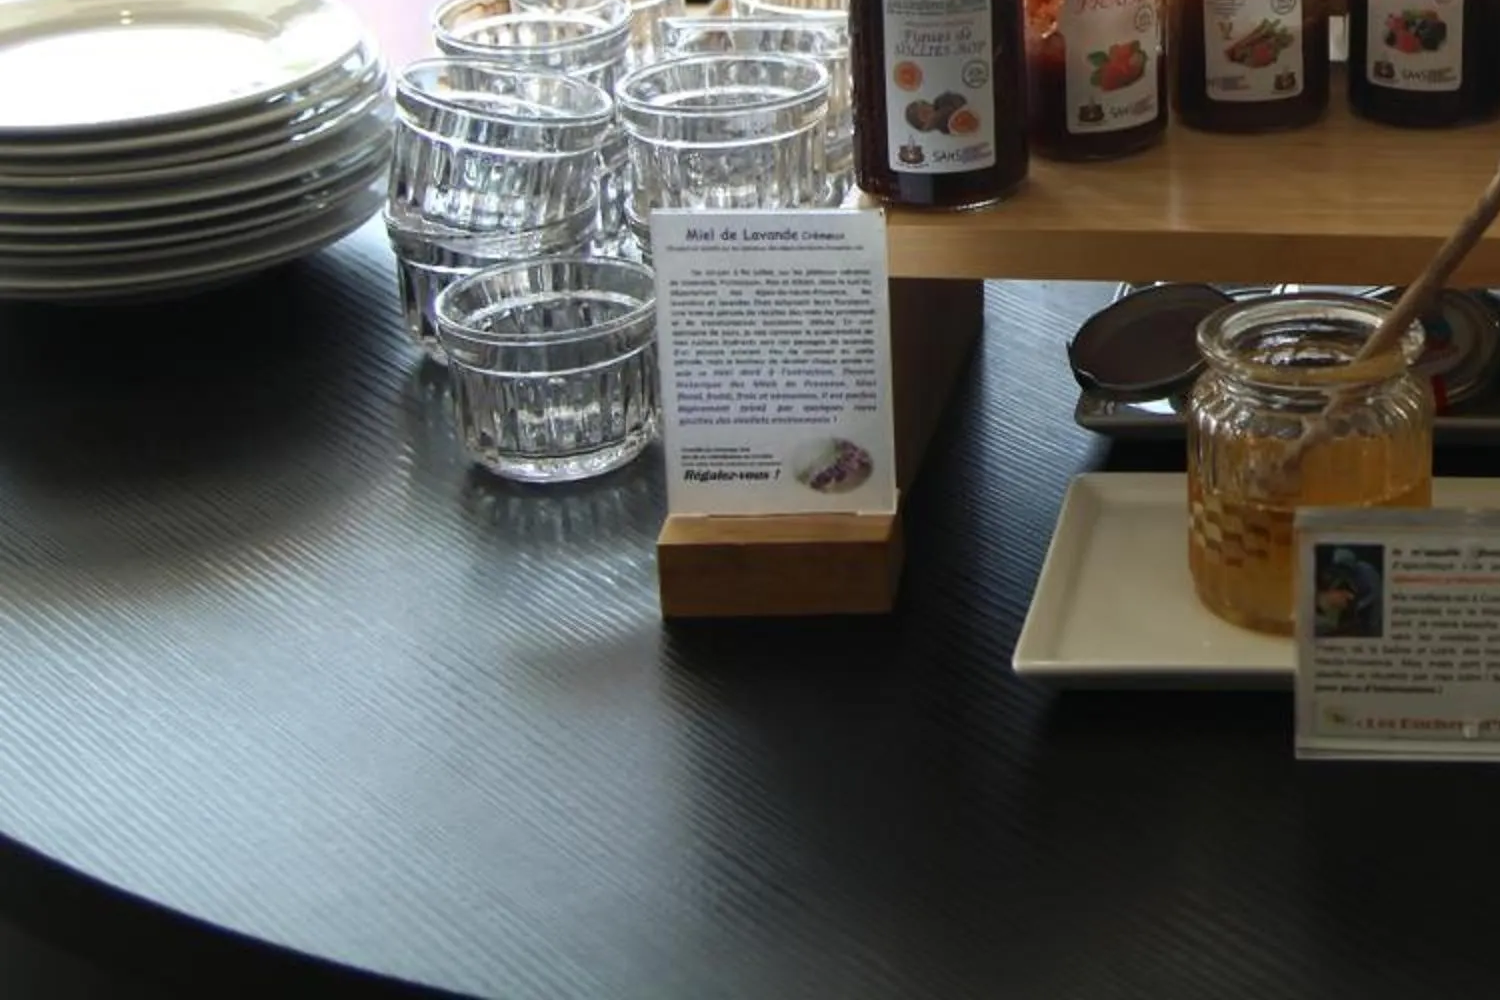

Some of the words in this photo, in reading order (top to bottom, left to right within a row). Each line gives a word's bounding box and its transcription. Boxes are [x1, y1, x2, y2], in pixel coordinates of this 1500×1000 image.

[685, 228, 715, 241] Miel
[720, 228, 737, 241] de
[743, 228, 799, 241] Lavande
